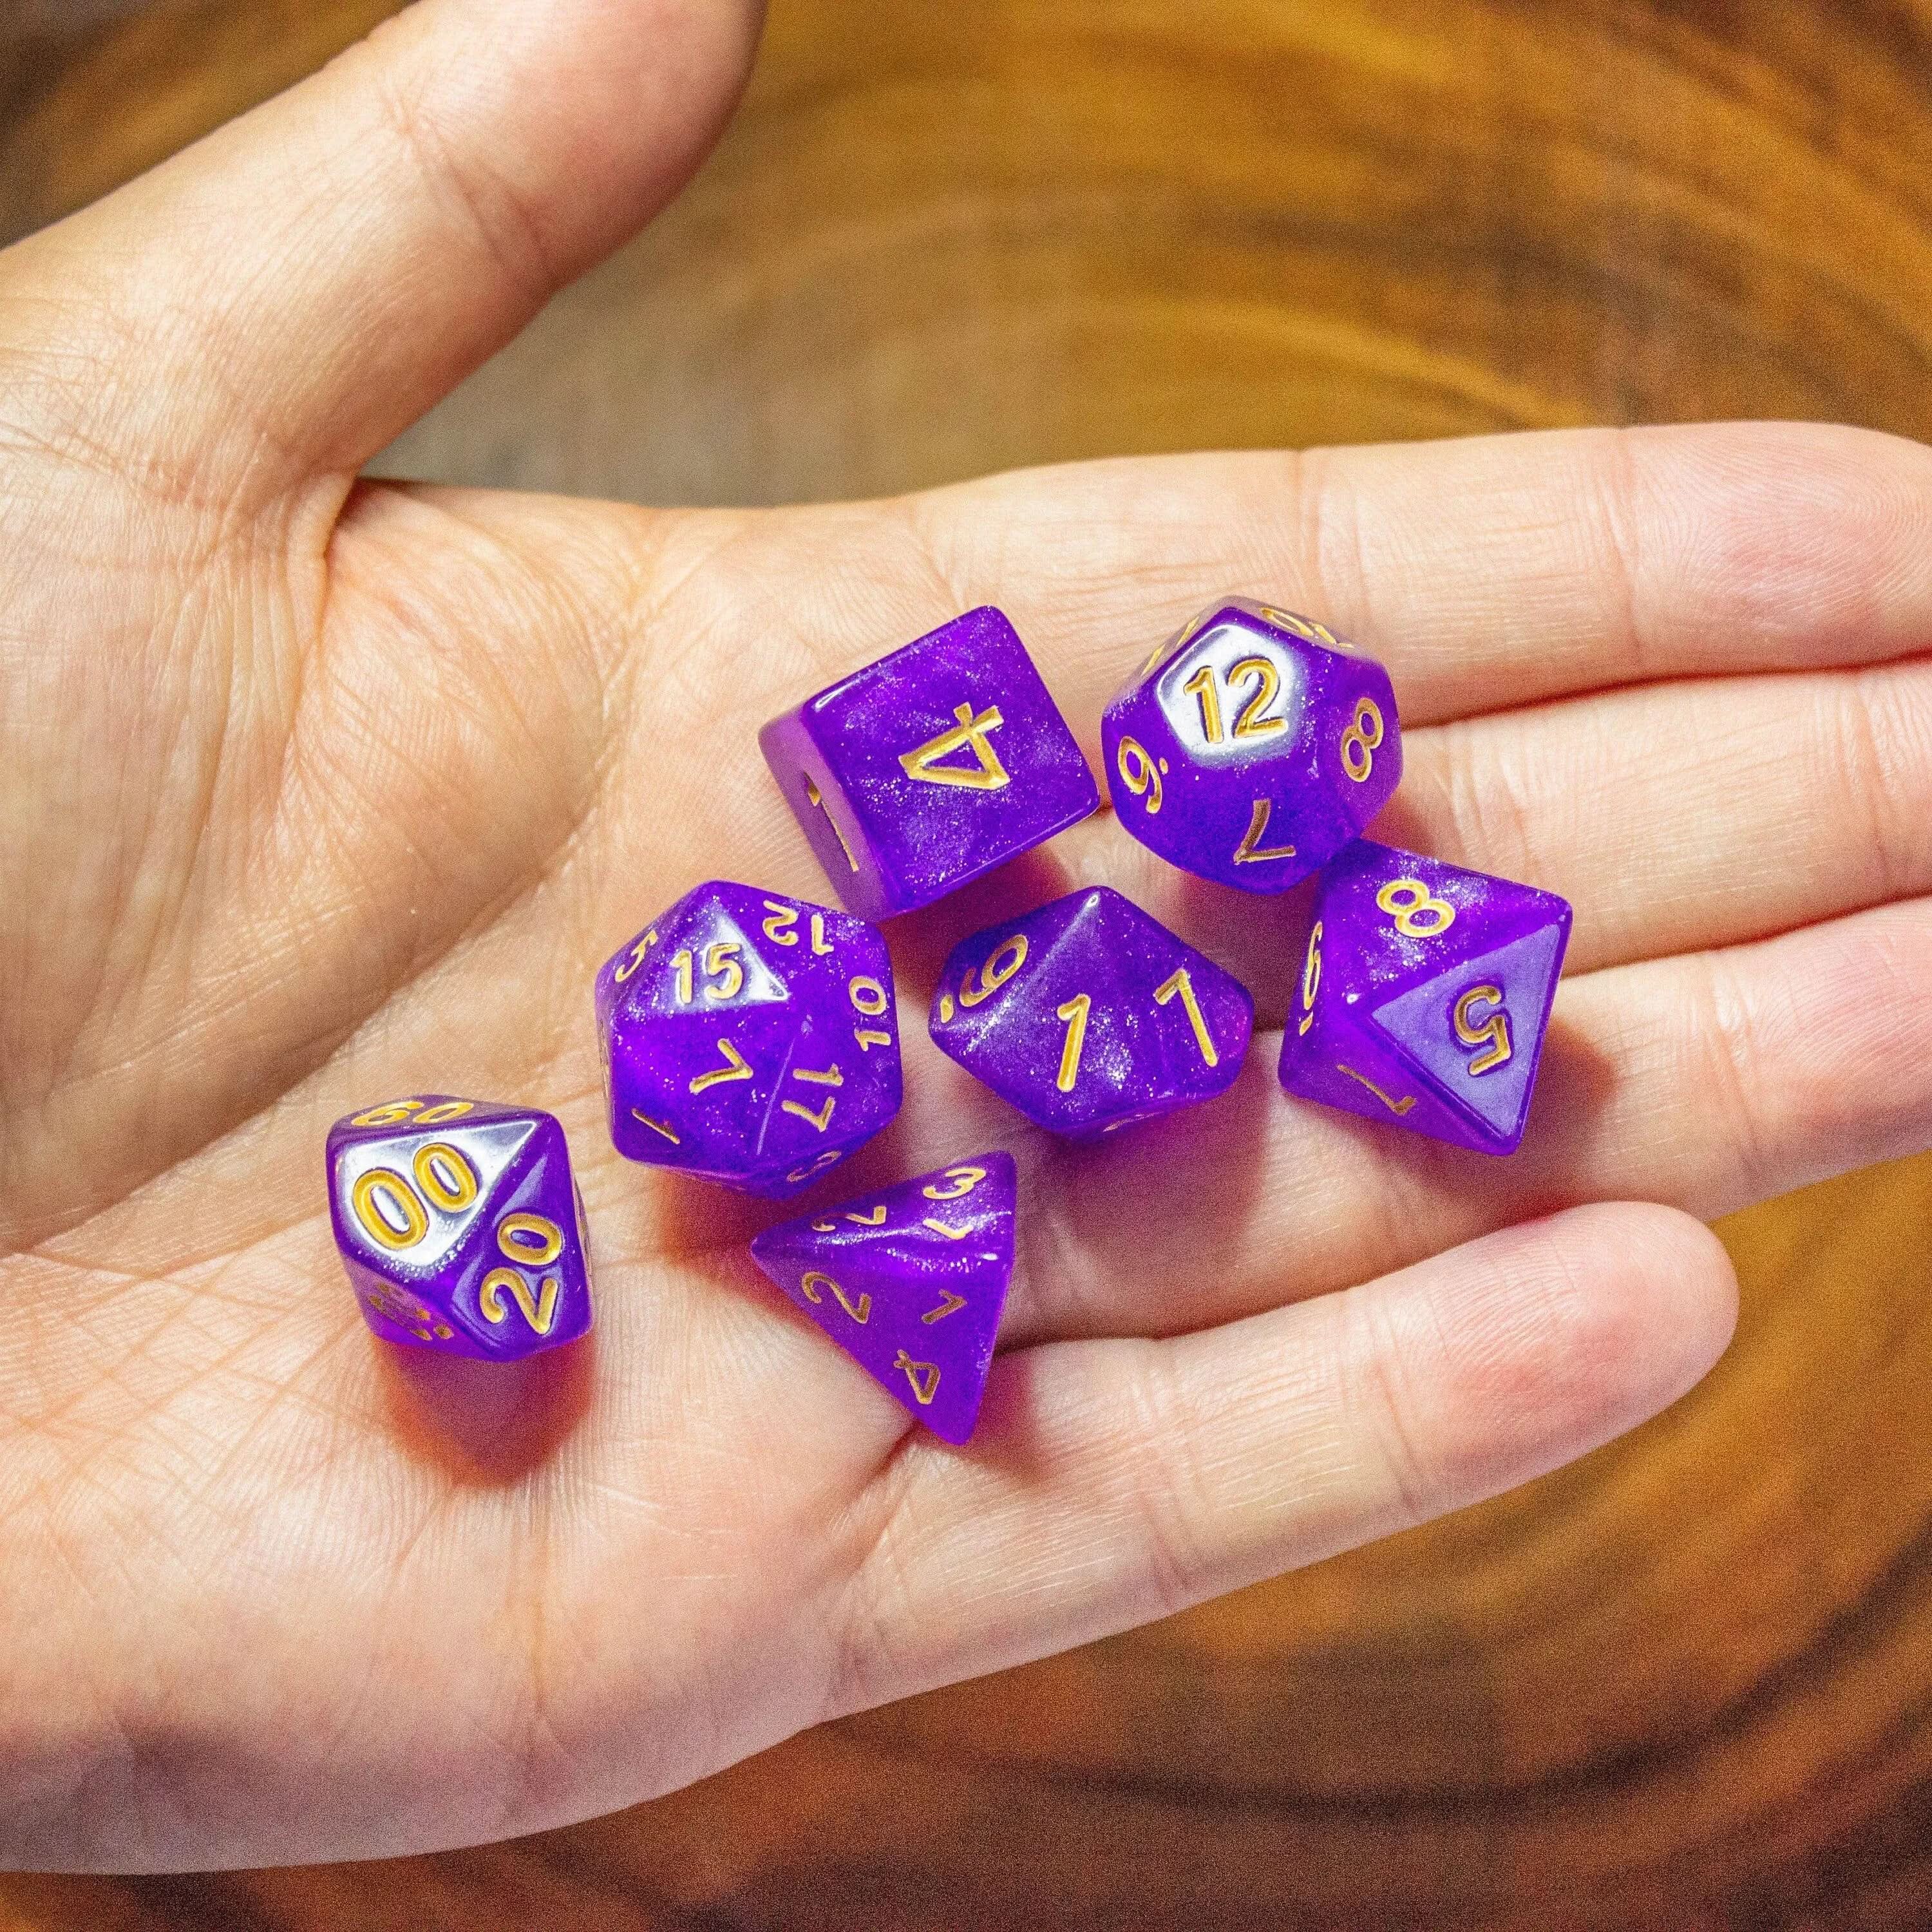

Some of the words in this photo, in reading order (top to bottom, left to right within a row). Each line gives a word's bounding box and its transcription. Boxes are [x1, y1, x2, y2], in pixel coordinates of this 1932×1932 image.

[1184, 656, 1289, 744] 12
[898, 701, 1011, 791] 4
[1341, 697, 1384, 783] 8
[1233, 797, 1296, 866] 7
[762, 900, 835, 956] 12
[1376, 879, 1456, 938] 8
[615, 930, 658, 983] 5
[670, 943, 743, 1004] 15
[848, 976, 892, 1052] 10
[1056, 993, 1091, 1092] 1
[1453, 985, 1511, 1077] 5
[689, 1038, 753, 1095] 7
[781, 1063, 844, 1133] 17
[351, 1101, 474, 1128] 60
[352, 1142, 478, 1250] 00
[922, 1167, 987, 1200] 3
[480, 1212, 564, 1335] 20
[801, 1271, 872, 1324] 2
[922, 1289, 968, 1325] 1
[893, 1349, 942, 1405] 4
